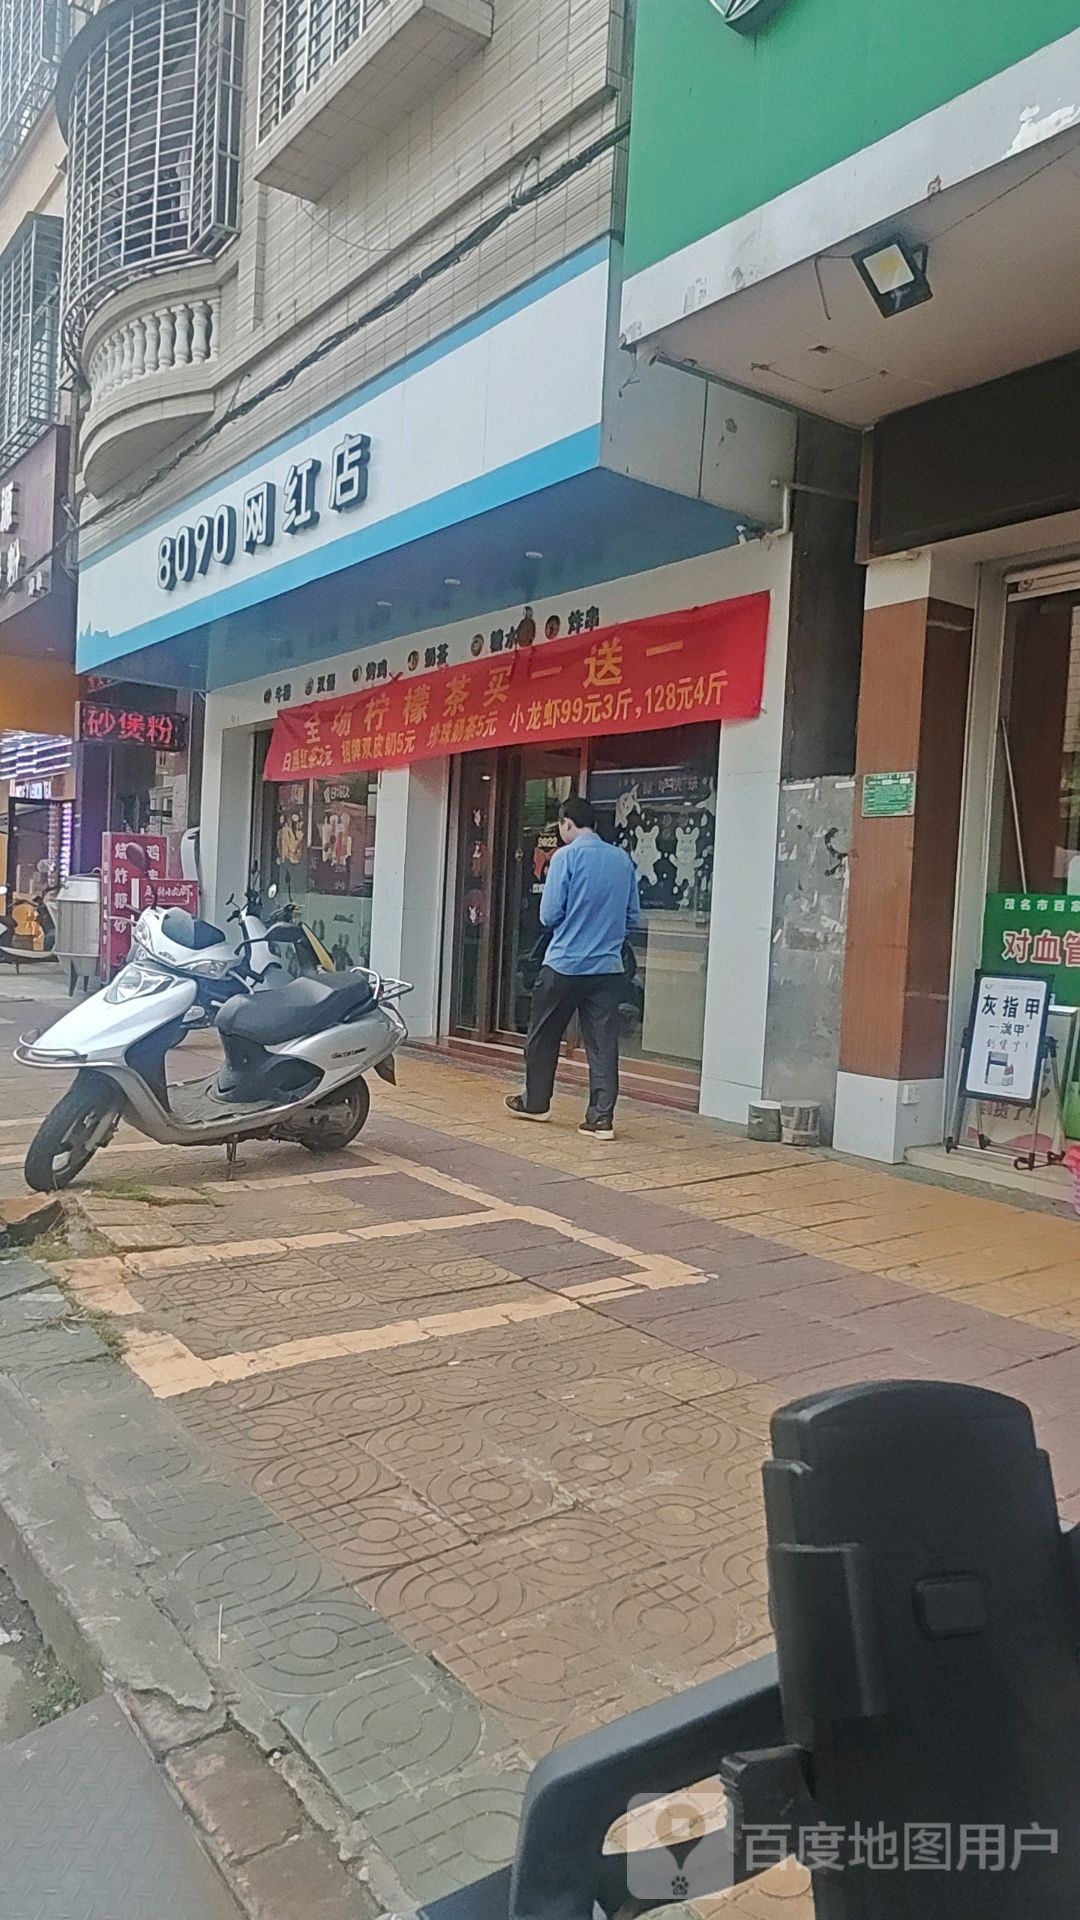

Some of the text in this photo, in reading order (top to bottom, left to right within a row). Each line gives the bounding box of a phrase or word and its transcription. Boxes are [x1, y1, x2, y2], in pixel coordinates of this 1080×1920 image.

[157, 433, 370, 590] 8090网红店
[424, 642, 449, 668] 奶茶
[566, 605, 600, 636] 炸串
[87, 705, 173, 744] 砂煲粉
[427, 710, 499, 749] 珍珠奶茶5元
[980, 994, 1041, 1021] 灰指甲
